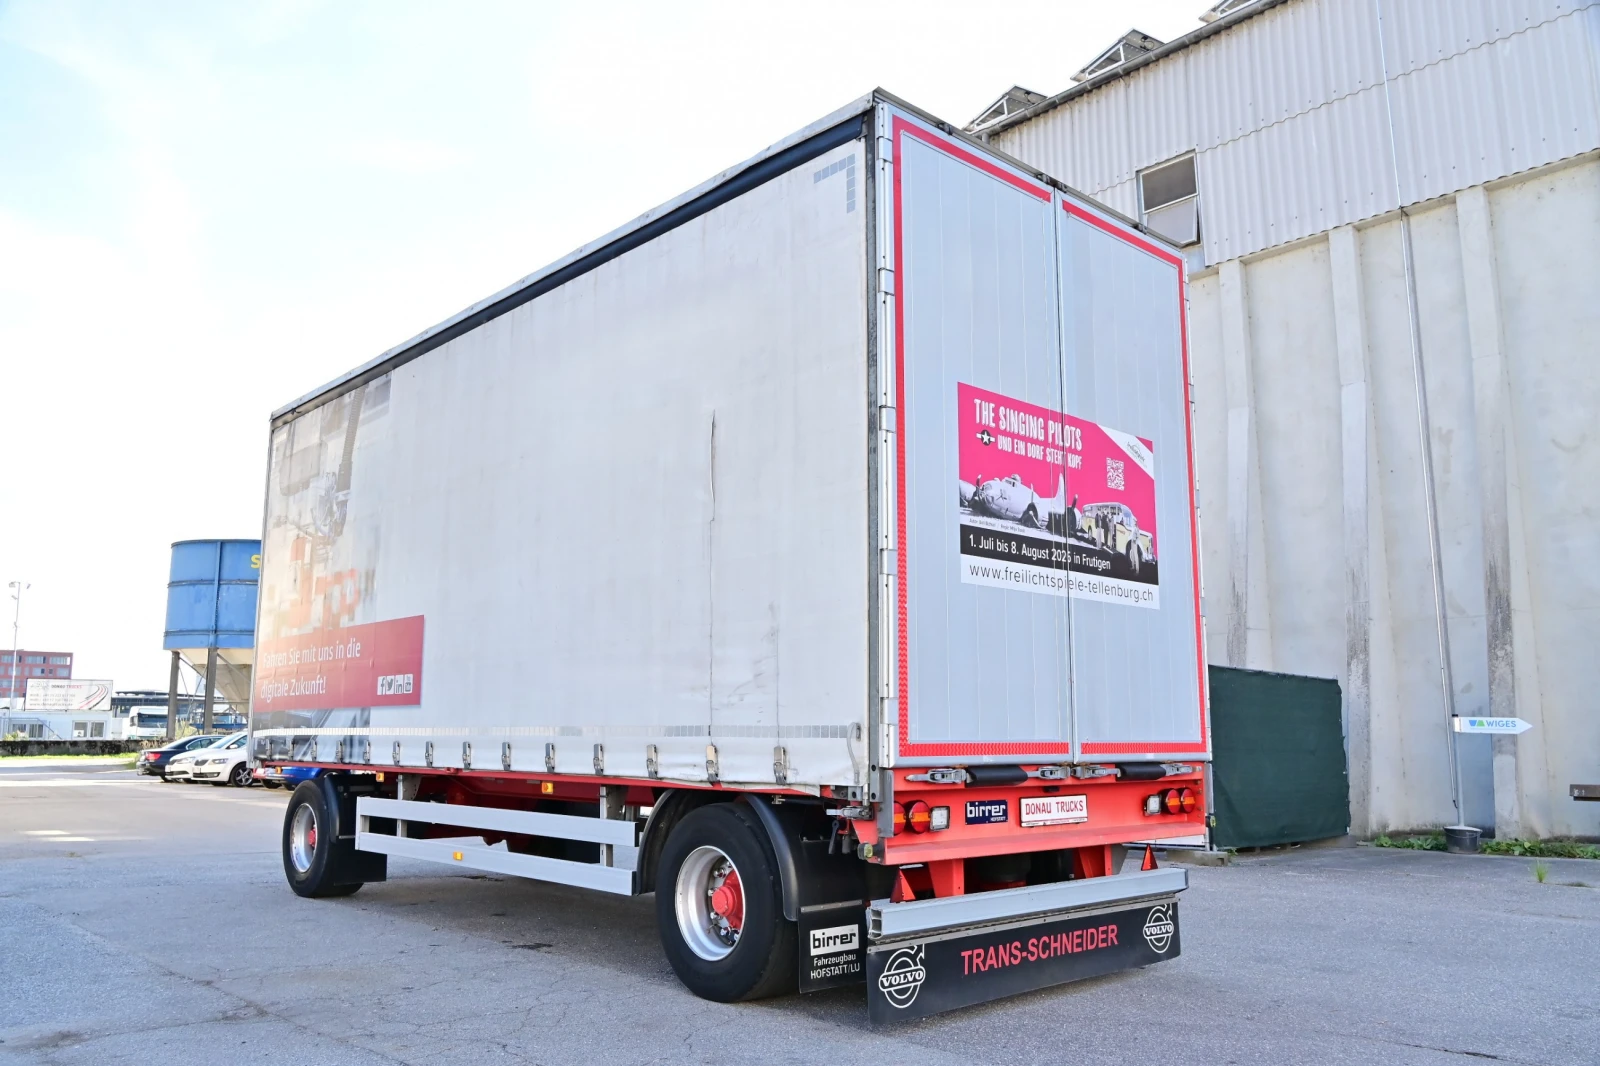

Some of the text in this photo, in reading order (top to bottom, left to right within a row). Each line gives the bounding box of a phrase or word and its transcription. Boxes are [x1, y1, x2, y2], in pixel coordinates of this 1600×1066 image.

[974, 398, 1082, 451] THE SINGING PILOTS
[997, 434, 1012, 453] UND
[1014, 439, 1026, 456] EIN
[1027, 442, 1044, 460] DORF
[1067, 453, 1082, 470] KOPF
[969, 534, 976, 547] 1.
[979, 536, 994, 550] Juli
[996, 538, 1009, 553] bis
[1011, 541, 1019, 554] 8.
[1021, 543, 1049, 560] August
[1073, 552, 1081, 565] in
[1082, 554, 1111, 571] Frutigen
[969, 563, 1154, 603] www.freilichtspiele-tellenburg.ch
[263, 637, 361, 668] Fahren Sie mit uns in die
[260, 674, 327, 703] digitale Zukunft!
[1486, 719, 1517, 728] WIGES
[966, 801, 1006, 818] birrer
[1025, 800, 1084, 815] DONAU TRUCKS
[1144, 924, 1173, 936] VOLVO
[812, 932, 856, 949] birrer
[961, 924, 1119, 976] TRANS-SCHNEIDER
[813, 953, 857, 967] Fahrzeugbau
[810, 962, 861, 980] HOFSTATT/LU
[881, 970, 924, 987] VOLVO
